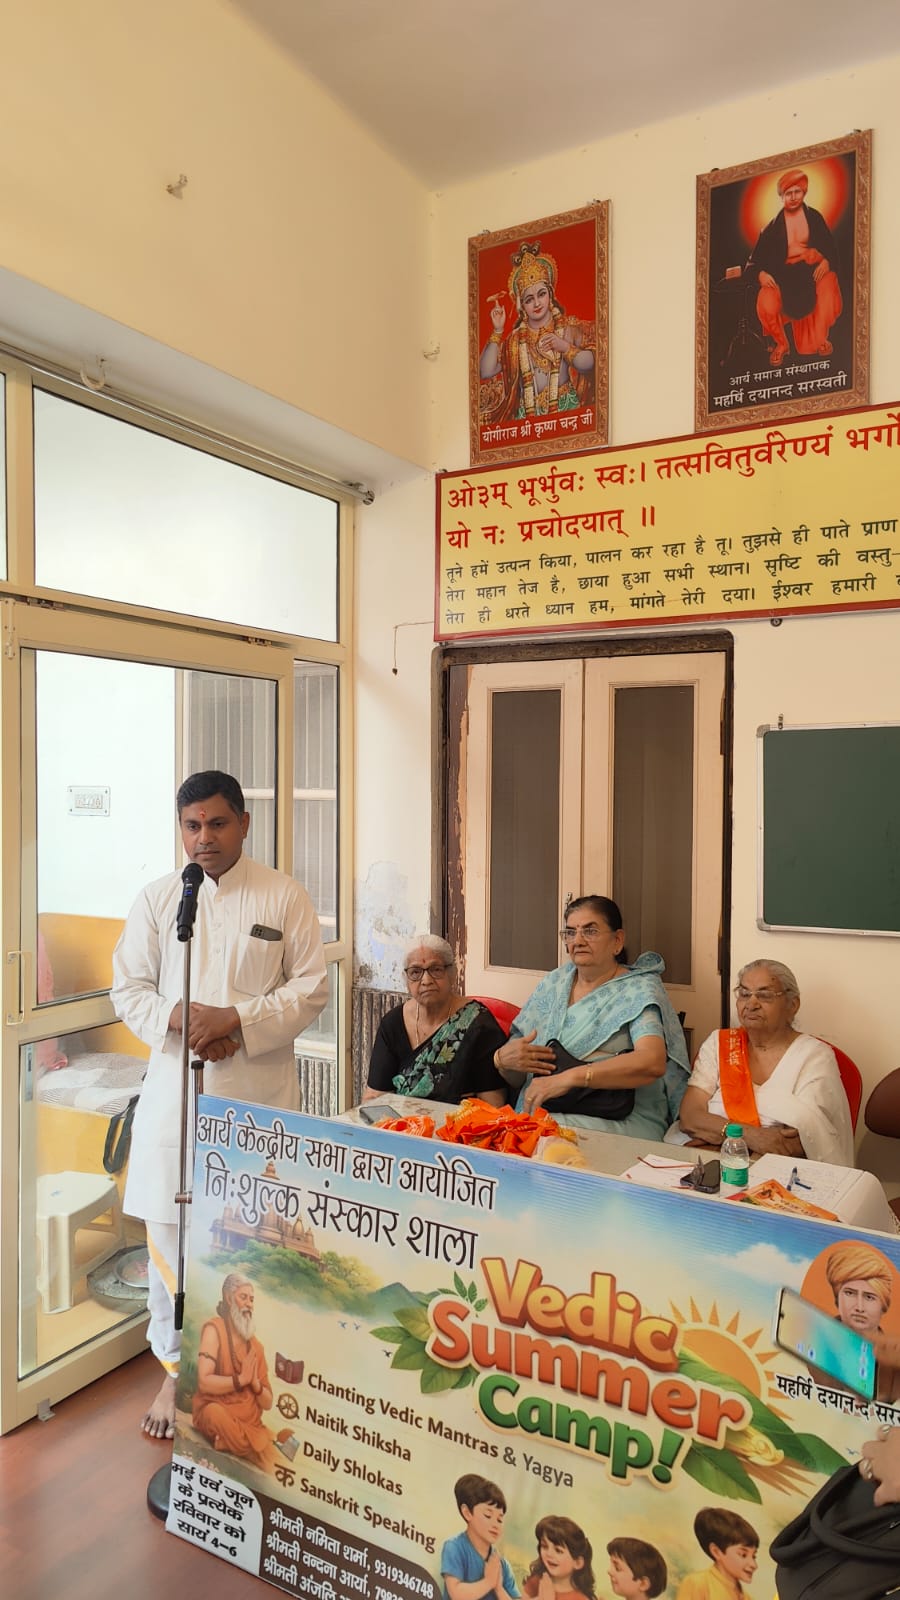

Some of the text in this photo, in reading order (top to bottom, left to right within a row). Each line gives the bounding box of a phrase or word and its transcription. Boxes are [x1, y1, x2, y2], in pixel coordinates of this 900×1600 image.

[713, 371, 847, 407] महर्षि दयानन्द सरस्वती
[730, 360, 831, 386] आर्य समाज संस्थापक
[482, 425, 518, 443] योगीराज
[520, 420, 532, 437] श्री
[559, 416, 578, 431] चन्द्र
[580, 408, 593, 425] जी
[448, 480, 512, 508] ओ३म्
[654, 424, 834, 480] तत्सवितुर्वरेण्यं
[446, 521, 471, 549] यो
[517, 508, 629, 543] प्रचोदयात्
[446, 563, 463, 584] तूने
[471, 560, 489, 578] हमें
[497, 559, 532, 574] उत्पन्न
[539, 553, 577, 570] किया,
[585, 549, 622, 564] पालन
[631, 546, 653, 559] कर
[662, 543, 686, 558] रहा
[695, 534, 706, 555] है
[742, 527, 782, 553] तुझसे
[792, 524, 810, 546] ही
[820, 519, 850, 540] पाते
[861, 519, 898, 537] प्राण
[446, 587, 465, 602] तेरा
[476, 585, 506, 600] महान
[518, 578, 539, 594] तेज
[577, 575, 609, 591] छाया
[622, 571, 650, 591] हुआ
[663, 563, 695, 582] सभी
[764, 553, 802, 577] सृष्टि
[817, 548, 841, 568] की
[446, 609, 465, 625] तेरा
[478, 606, 492, 624] ही
[505, 602, 531, 619] धरते
[545, 602, 575, 616] ध्यान
[630, 590, 666, 609] मांगते
[681, 587, 706, 606] तेरी
[772, 579, 814, 602] ईश्वर
[831, 572, 877, 595] हमारी
[197, 1110, 497, 1210] आर्य केन्द्रीय सभा द्वारा आयोजित
[307, 1180, 400, 1247] संस्कार
[406, 1216, 479, 1269] शाला
[481, 1257, 680, 1373] Vedic
[430, 1299, 746, 1442] Summer
[776, 1374, 813, 1400] महर्षि
[305, 1406, 412, 1462] Naitik Shiksha
[307, 1373, 574, 1488] Chanting Vedic Mantras & Yagya
[477, 1373, 685, 1484] Camp!
[171, 1462, 255, 1511] मई एवं जून
[274, 1463, 296, 1488] क
[303, 1441, 403, 1497] Daily Shlokas
[173, 1498, 246, 1543] रविवार को
[178, 1482, 244, 1521] के प्रत्येक
[300, 1477, 437, 1554] Sanskrit Speaking
[177, 1519, 210, 1542] सायं
[266, 1531, 300, 1563] श्रीमती
[302, 1550, 338, 1580] वन्दना
[269, 1507, 304, 1539] श्रीमती
[306, 1526, 341, 1556] नमिता
[374, 1559, 434, 1599] 9319346748
[263, 1554, 298, 1586] श्रीमती
